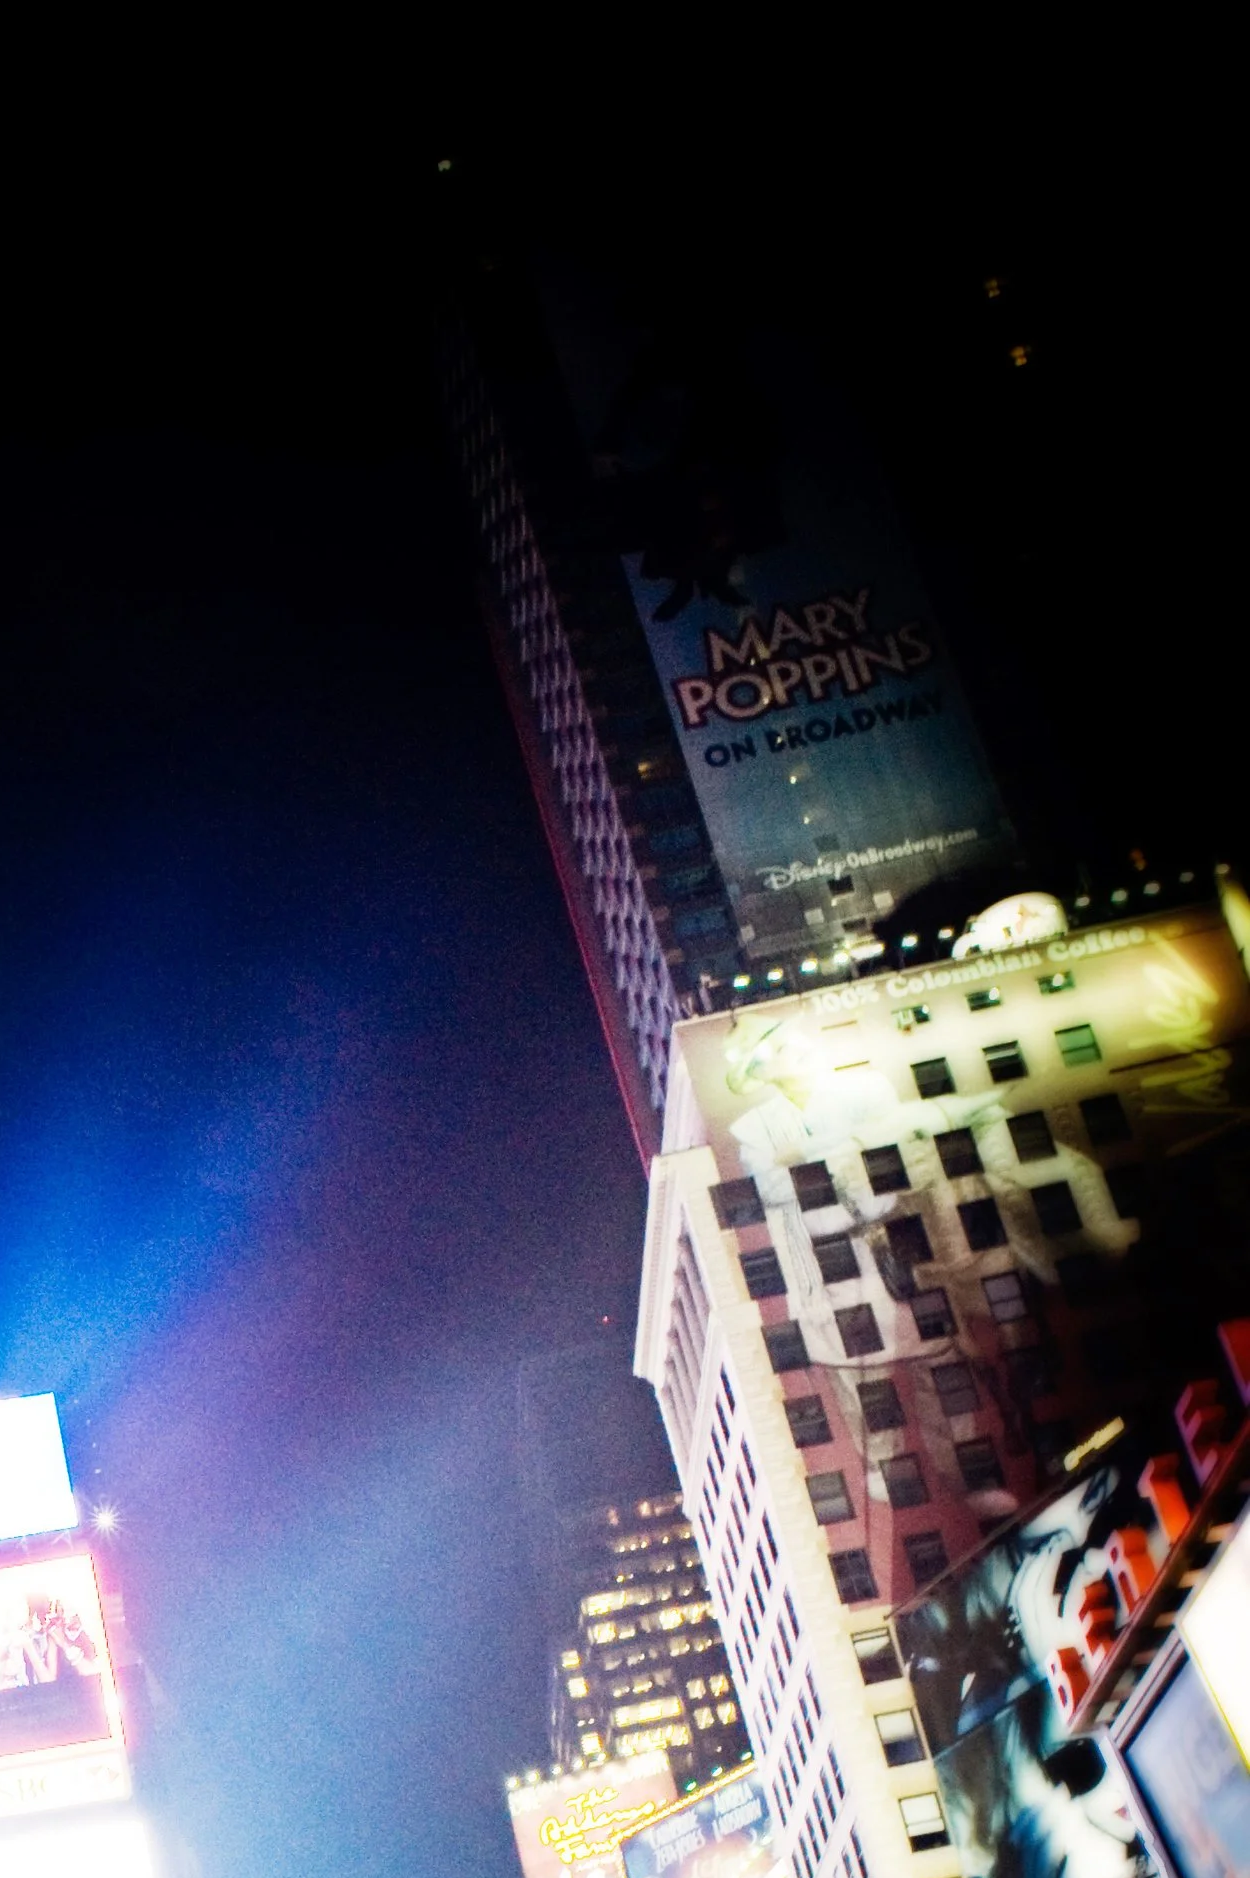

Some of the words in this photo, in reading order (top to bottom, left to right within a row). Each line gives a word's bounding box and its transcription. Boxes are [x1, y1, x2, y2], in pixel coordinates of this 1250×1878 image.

[704, 587, 870, 673] MARY
[672, 618, 933, 728] POPPINS
[704, 737, 756, 768] ON
[764, 690, 943, 753] BROADWAY
[886, 949, 1042, 998] Colombian
[1046, 926, 1146, 963] Coffee
